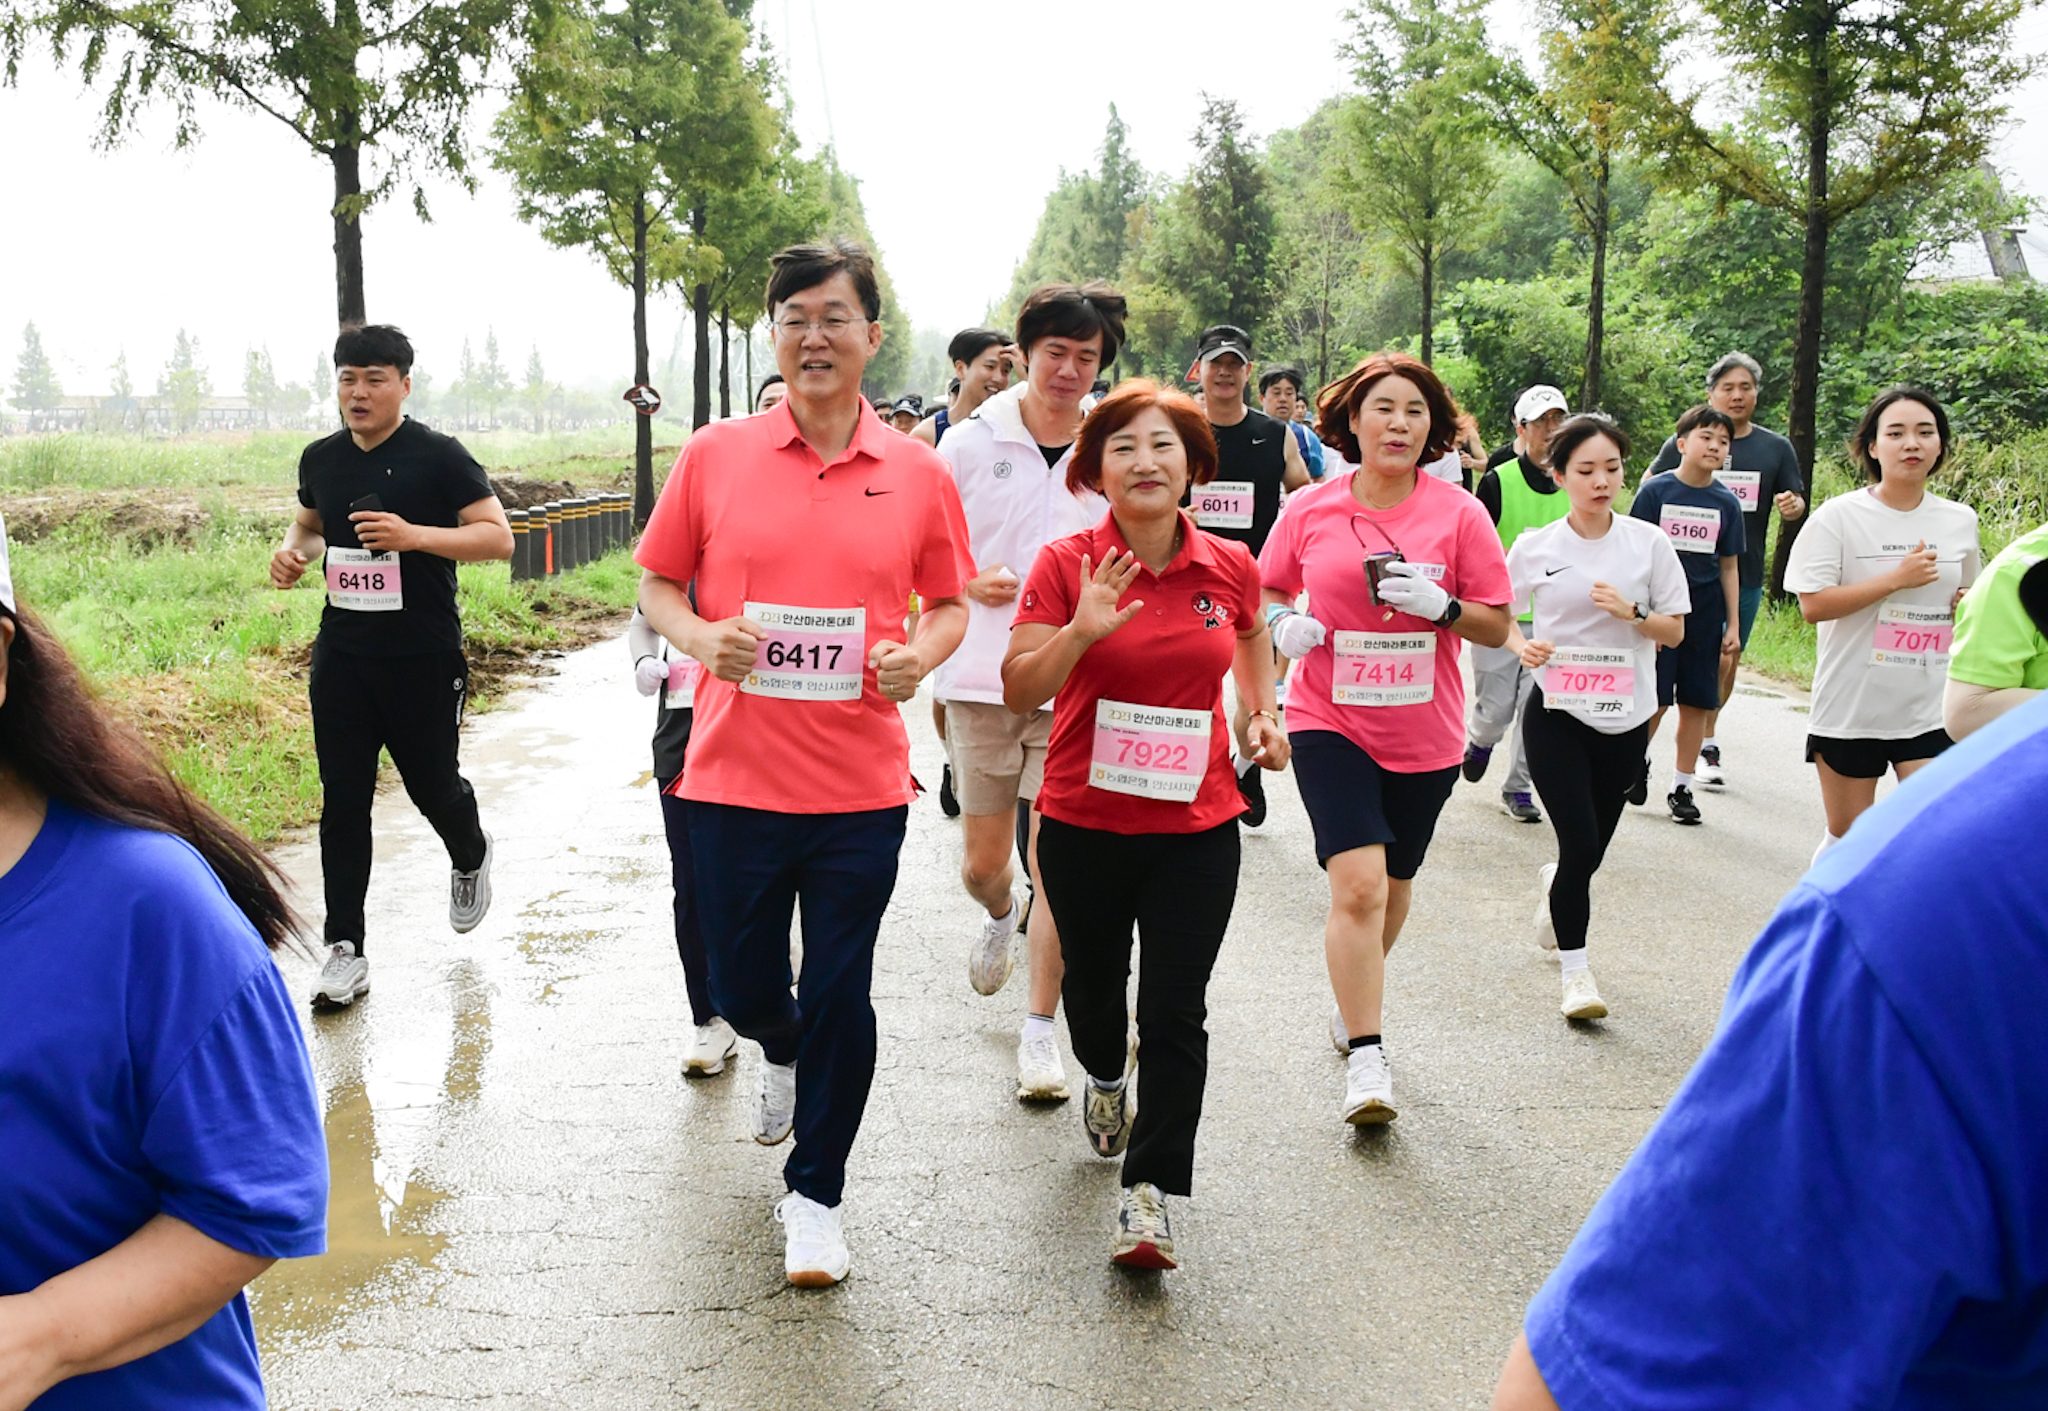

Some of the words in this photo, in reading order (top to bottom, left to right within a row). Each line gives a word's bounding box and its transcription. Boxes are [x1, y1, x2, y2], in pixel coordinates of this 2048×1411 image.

[1202, 499, 1239, 512] 6011
[1670, 523, 1708, 539] 5160
[339, 572, 385, 590] 6418
[783, 613, 855, 627] 안산마라톤대회
[1363, 640, 1426, 650] 안산마라톤대회
[1894, 630, 1941, 651] 7071
[766, 641, 843, 670] 6417
[1352, 662, 1414, 684] 7414
[759, 676, 803, 690] 농협은행
[1561, 673, 1616, 692] 7072
[1108, 708, 1132, 722] 2023
[1133, 712, 1201, 729] 안산마라톤대회
[1117, 738, 1189, 771] 7922
[1106, 772, 1149, 788] 농협은행
